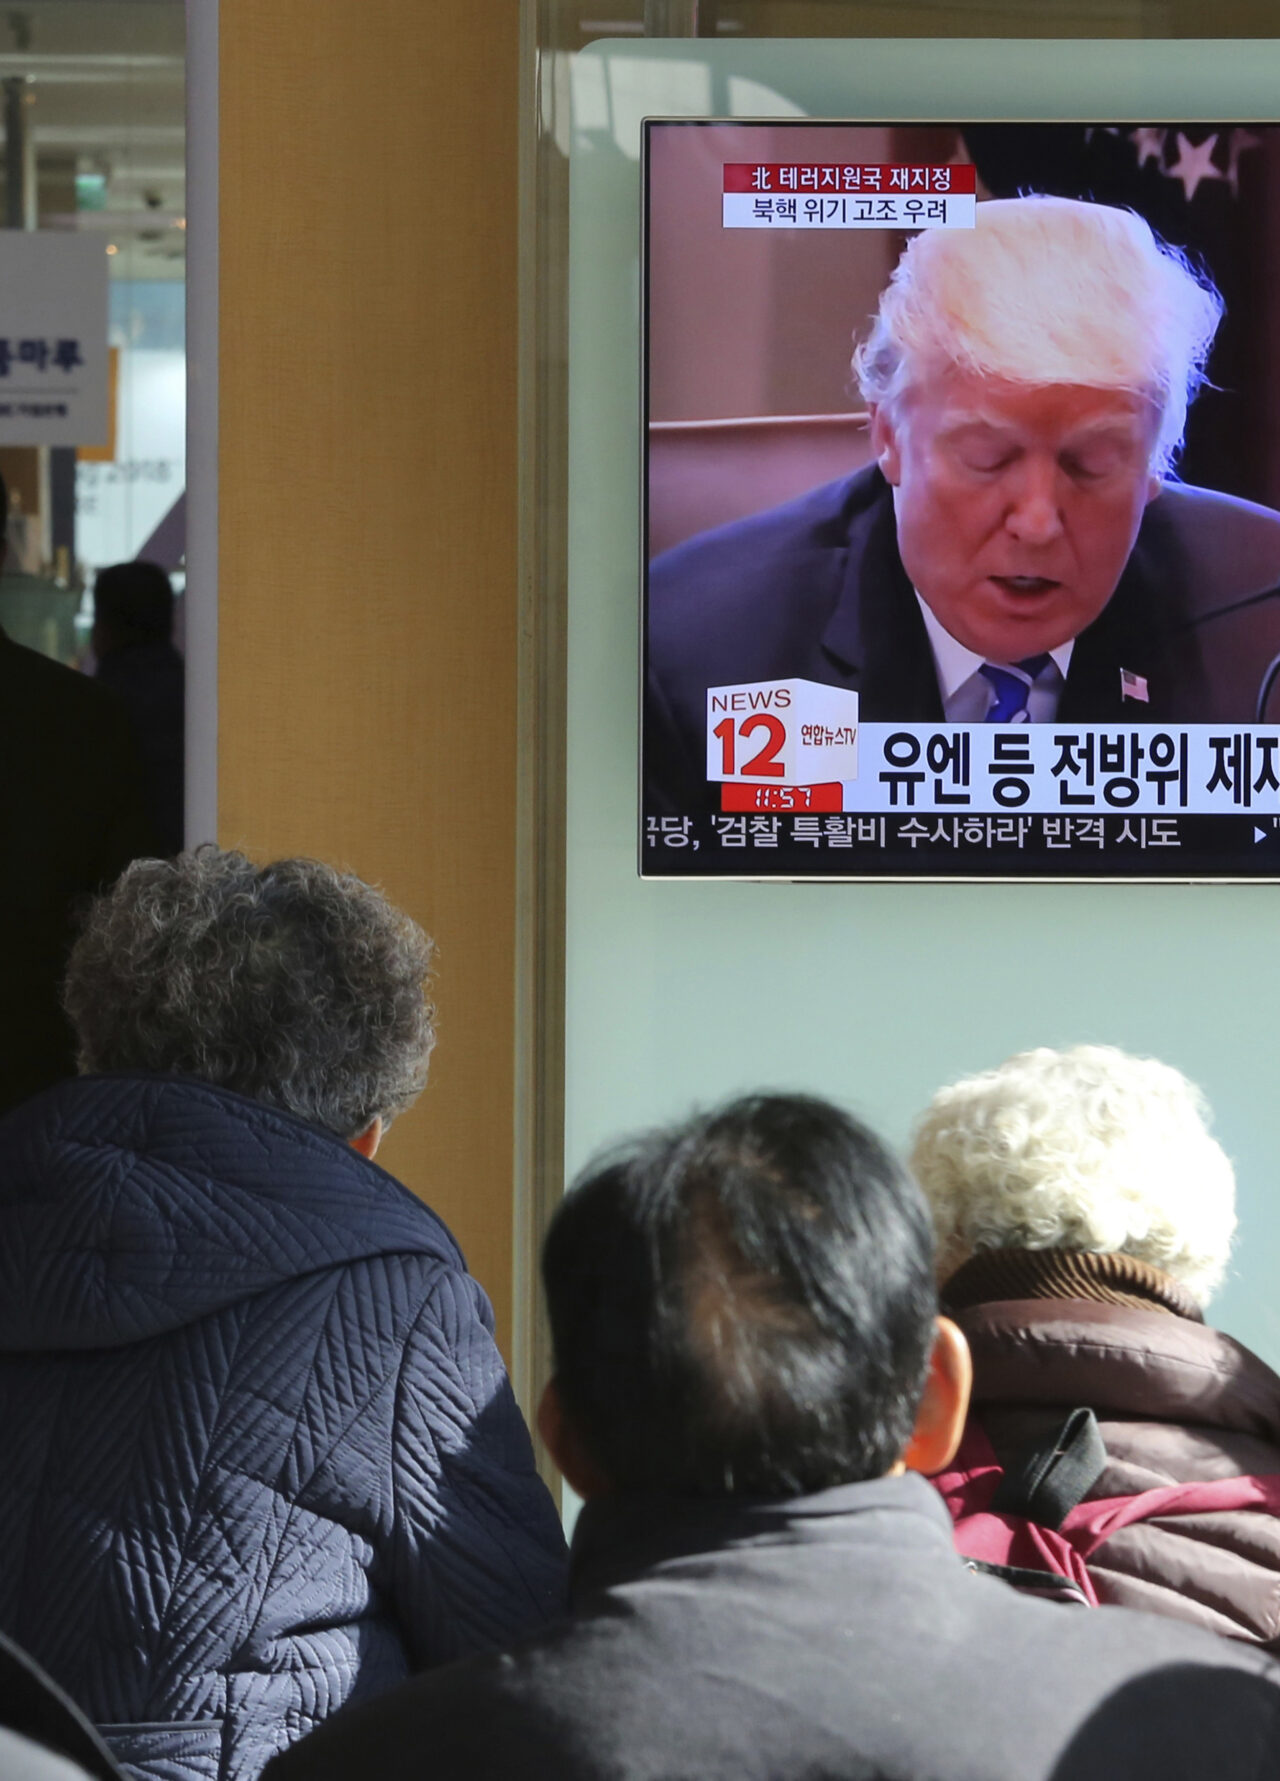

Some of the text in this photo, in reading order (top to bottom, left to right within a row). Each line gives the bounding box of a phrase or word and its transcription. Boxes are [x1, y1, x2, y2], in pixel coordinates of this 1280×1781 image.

[752, 166, 951, 190] 北 테러지원국 재지정
[752, 198, 948, 223] 북핵 위기 고조 우려
[712, 689, 791, 712] NEWS
[713, 713, 786, 777] 12
[801, 724, 856, 746] 연합뉴스TV
[879, 732, 971, 805] 유엔
[988, 733, 1035, 807] 등
[1050, 732, 1188, 807] 전방위
[754, 787, 812, 808] 11:57
[790, 815, 886, 848] 특활비
[897, 815, 1032, 849] 수사하라'
[1042, 817, 1105, 849] 반격
[1115, 817, 1181, 849] 시도
